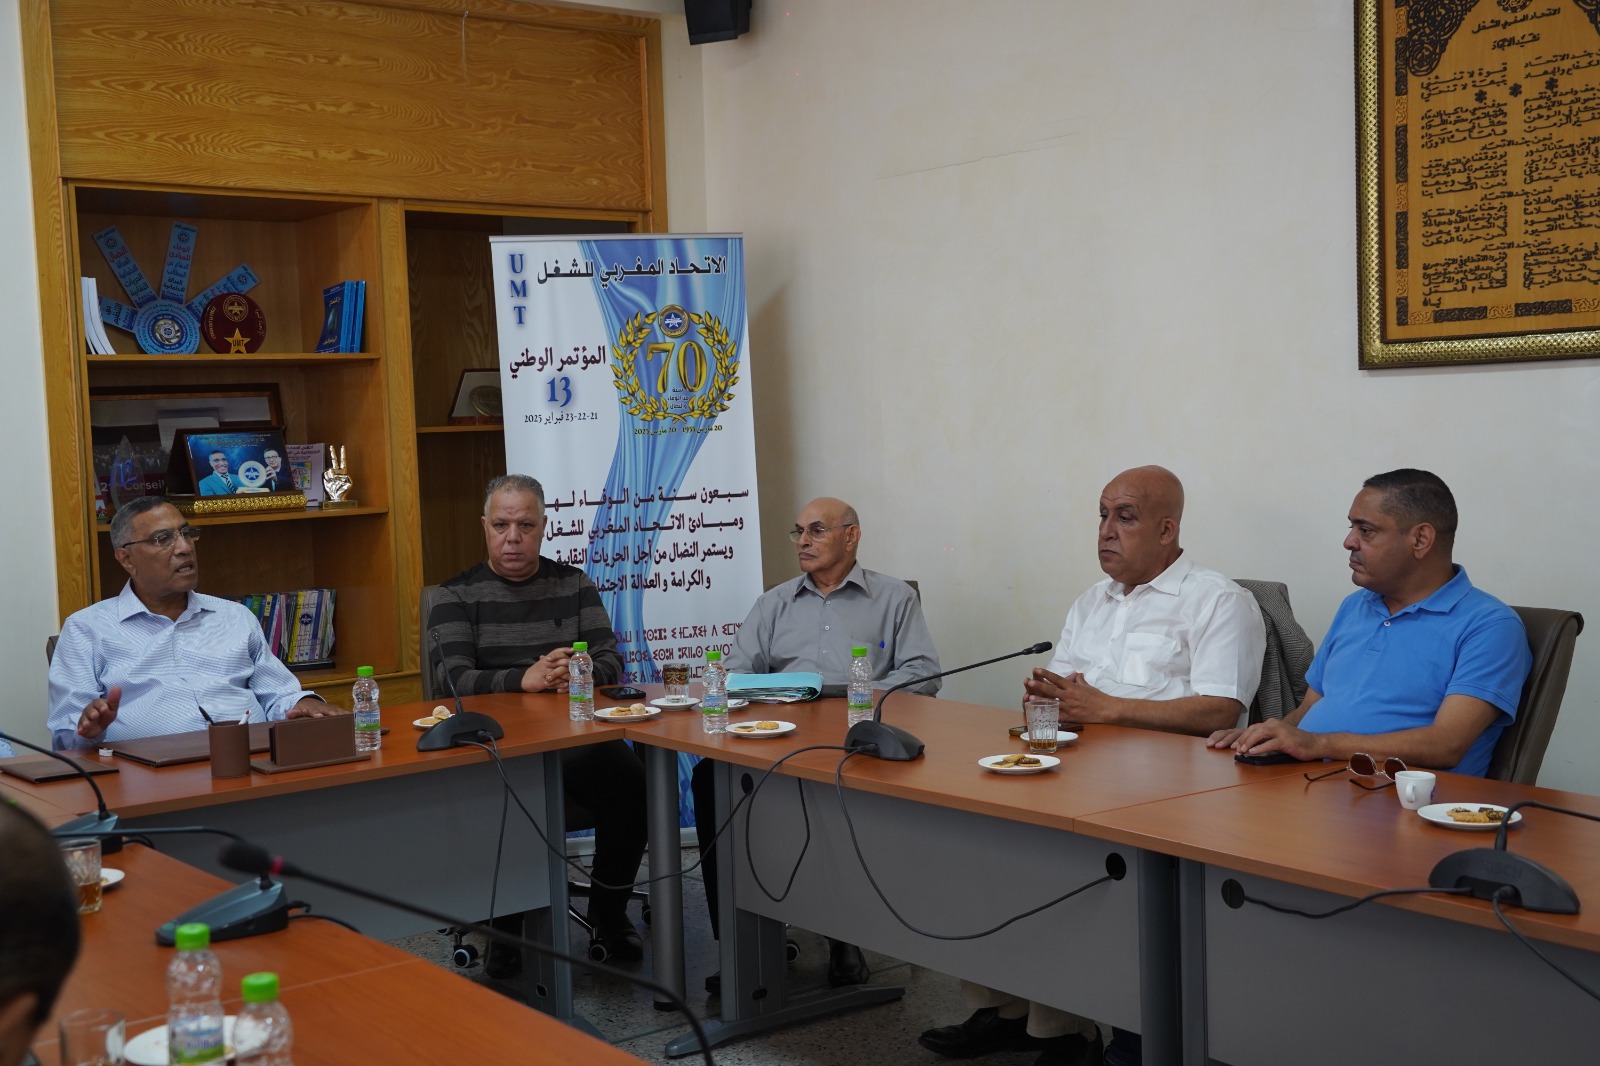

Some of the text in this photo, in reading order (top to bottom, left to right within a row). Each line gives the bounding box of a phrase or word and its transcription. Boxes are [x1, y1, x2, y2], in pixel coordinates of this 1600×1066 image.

[538, 256, 726, 288] الاتحاد المغربي للشغل
[510, 254, 527, 324] UMT
[232, 339, 244, 347] UMT
[510, 345, 606, 379] المؤتمر الوطني
[646, 341, 708, 393] 70
[547, 376, 572, 407] 13
[524, 414, 542, 423] 2025
[544, 410, 564, 425] فبراير
[545, 486, 749, 512] سبعون سنة من الوفاء له
[546, 512, 744, 544] ومبادئ الاتحاد المغربي للشغل
[591, 545, 629, 568] الحريات
[633, 539, 652, 565] أجل
[654, 549, 667, 565] من
[669, 541, 699, 562] النضال
[701, 543, 734, 562] ويستمر
[594, 574, 628, 595] الاجتما
